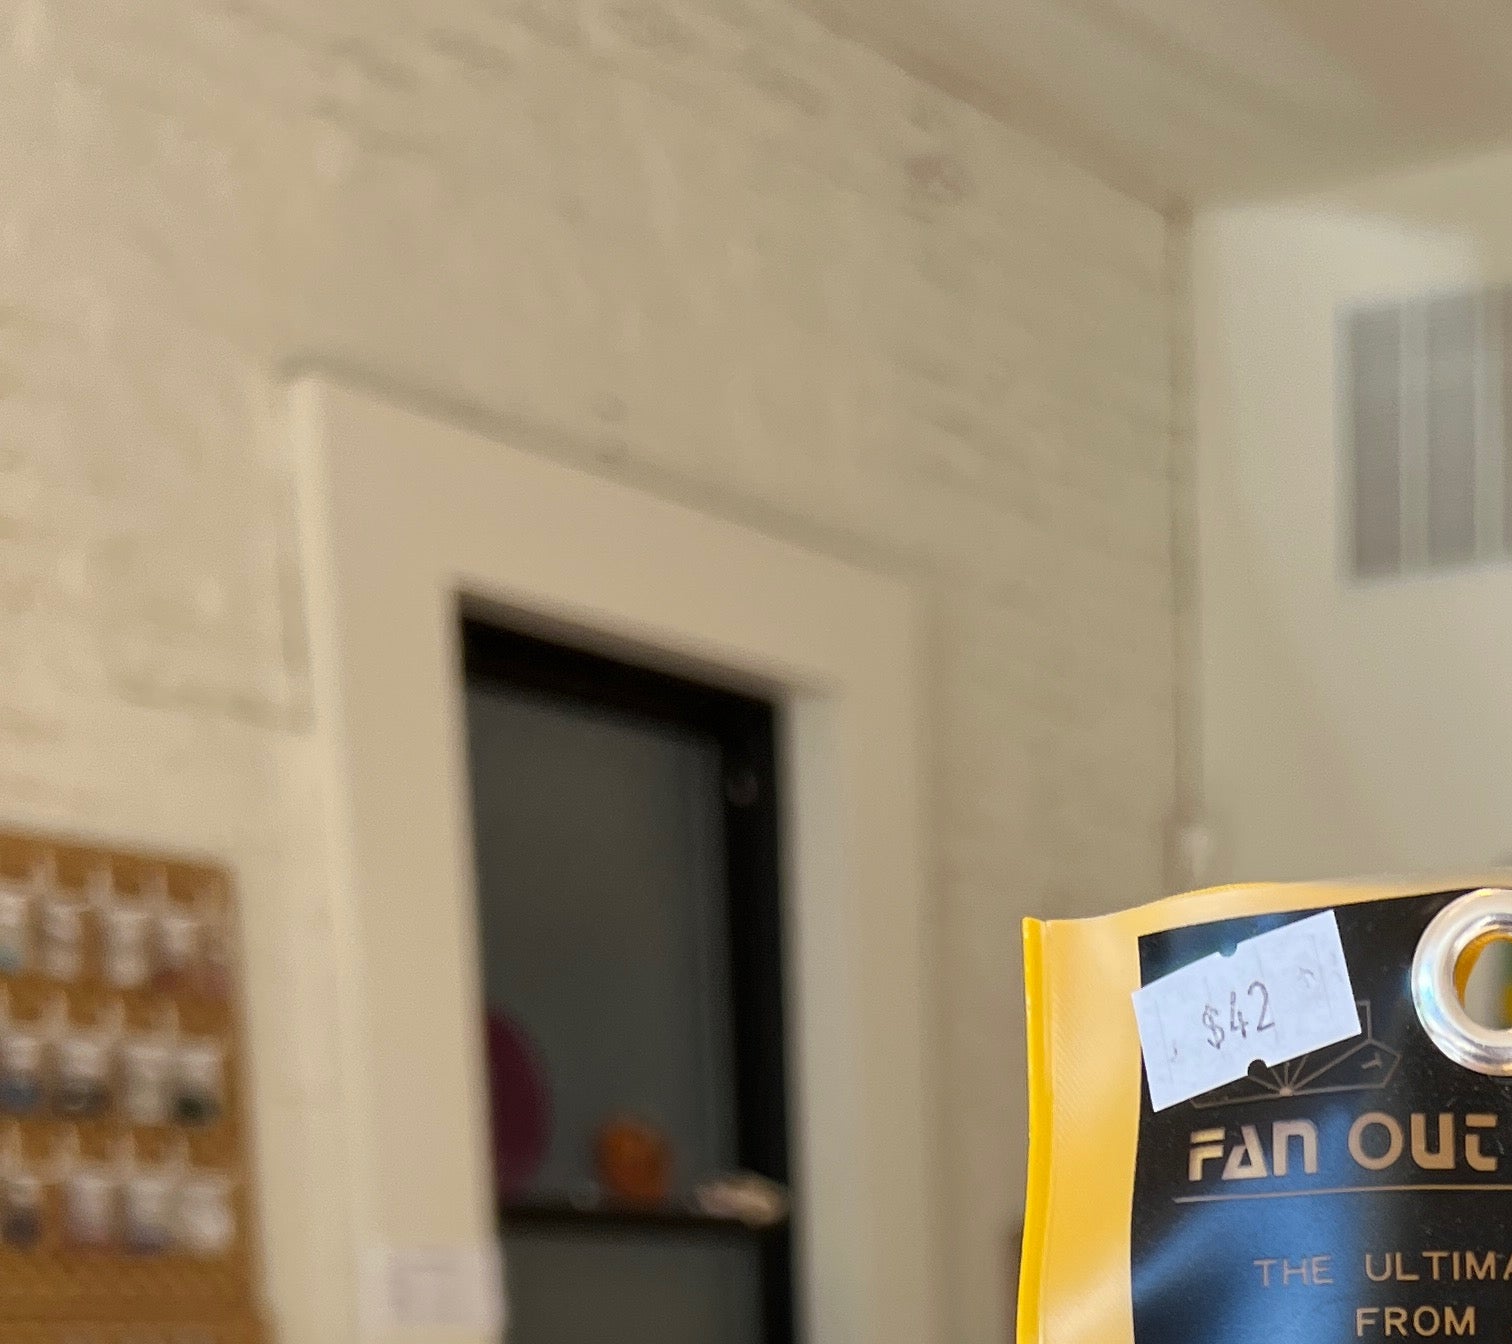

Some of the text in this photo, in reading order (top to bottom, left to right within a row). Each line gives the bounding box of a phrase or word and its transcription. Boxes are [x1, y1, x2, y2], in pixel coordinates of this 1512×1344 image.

[1201, 980, 1276, 1050] $42
[1188, 1118, 1318, 1182] FAN
[1348, 1111, 1498, 1172] OUT
[1253, 1255, 1334, 1287] THE
[1356, 1305, 1476, 1337] FROM
